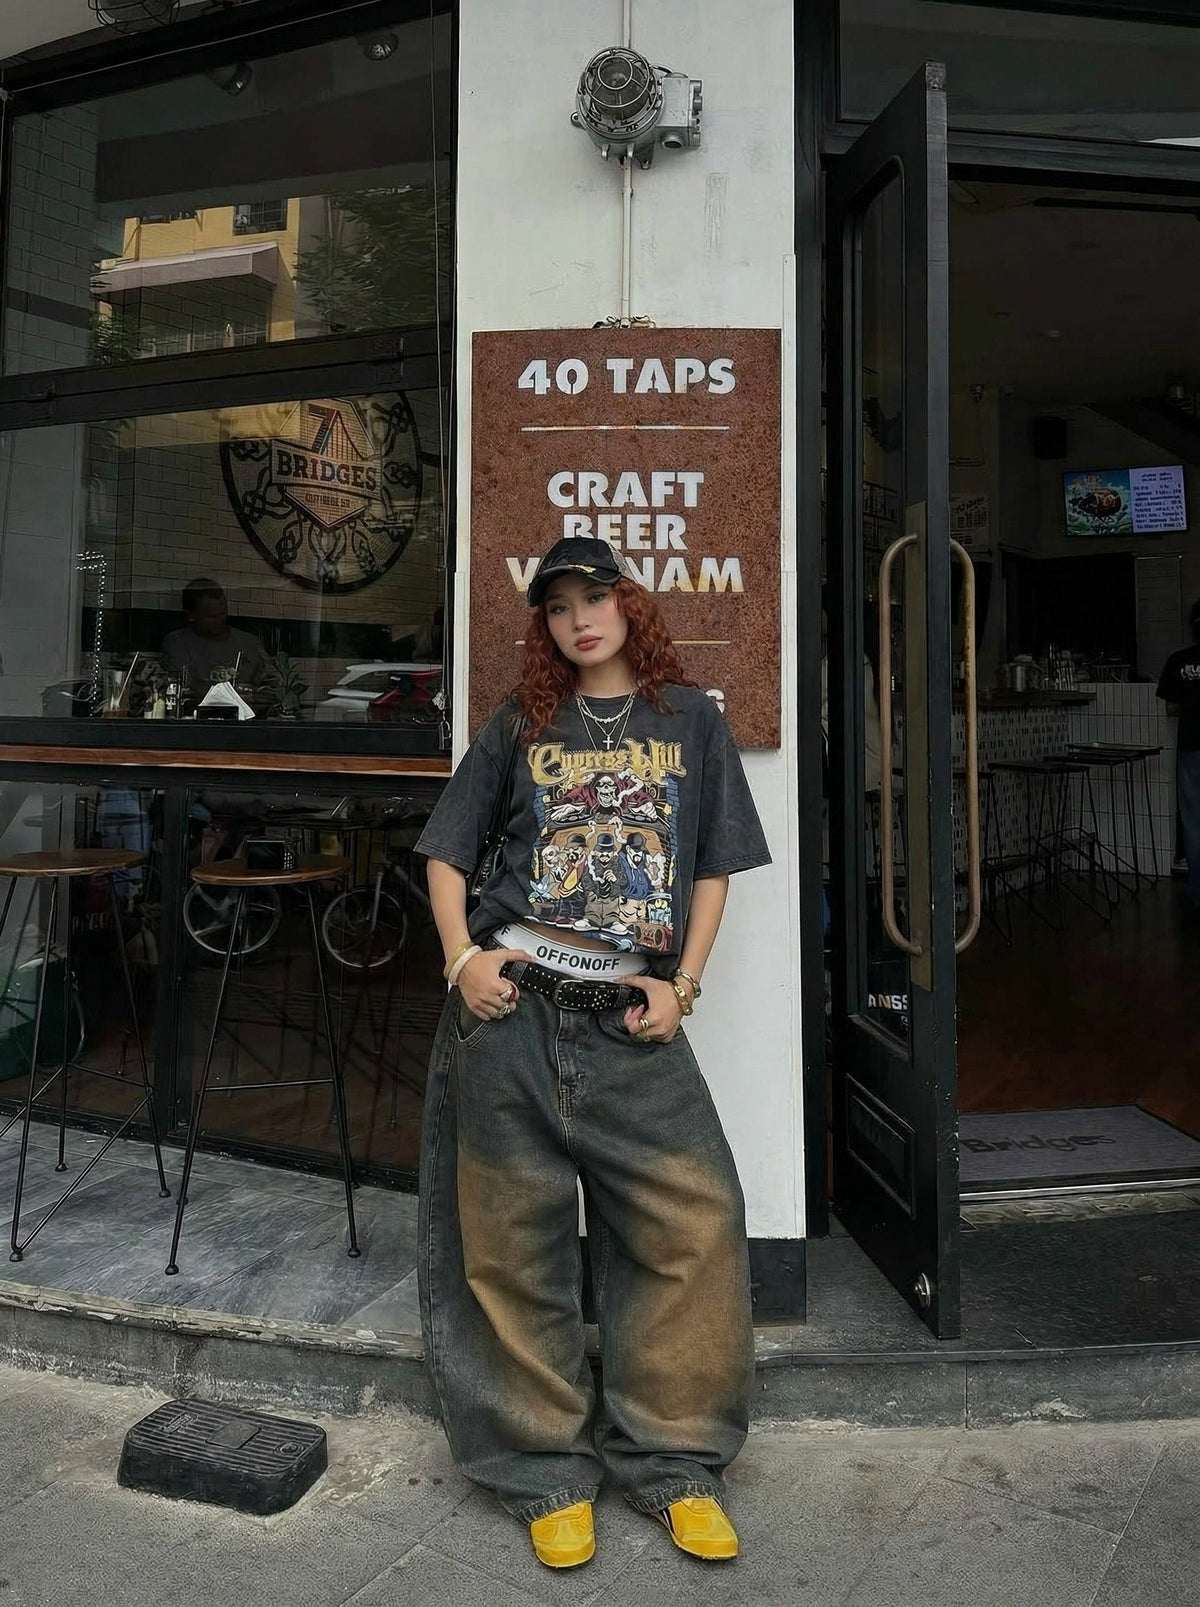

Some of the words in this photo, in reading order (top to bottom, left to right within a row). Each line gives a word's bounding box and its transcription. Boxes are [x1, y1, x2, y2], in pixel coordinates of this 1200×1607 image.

[518, 358, 589, 395] 40
[607, 358, 737, 394] TAPS
[276, 451, 377, 491] BRIDGES
[547, 471, 705, 508] CRAFT
[563, 513, 688, 550] BEER
[505, 557, 745, 592] VNAM
[536, 945, 620, 971] OFFONOFF
[959, 1135, 1116, 1152] Bridges
